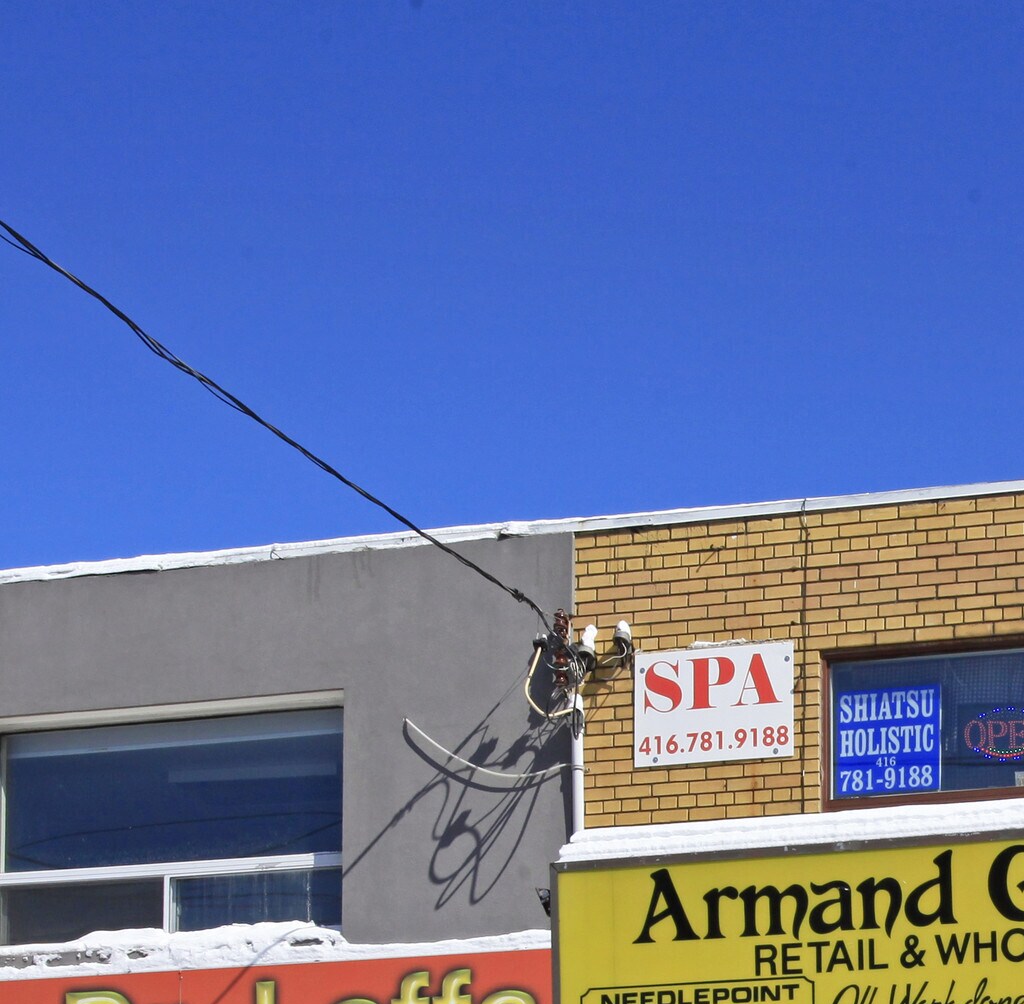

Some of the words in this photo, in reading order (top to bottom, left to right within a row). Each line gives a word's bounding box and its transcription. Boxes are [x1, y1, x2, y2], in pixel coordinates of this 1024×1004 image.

[643, 653, 782, 715] SPA
[839, 689, 935, 724] SHIATSU
[638, 724, 790, 757] 416.781.9188
[840, 722, 935, 758] HOLISTIC
[840, 764, 933, 792] 781-9188
[876, 756, 897, 768] 416
[632, 849, 958, 944] Armand
[755, 938, 889, 976] RETAIL
[900, 934, 926, 968] &
